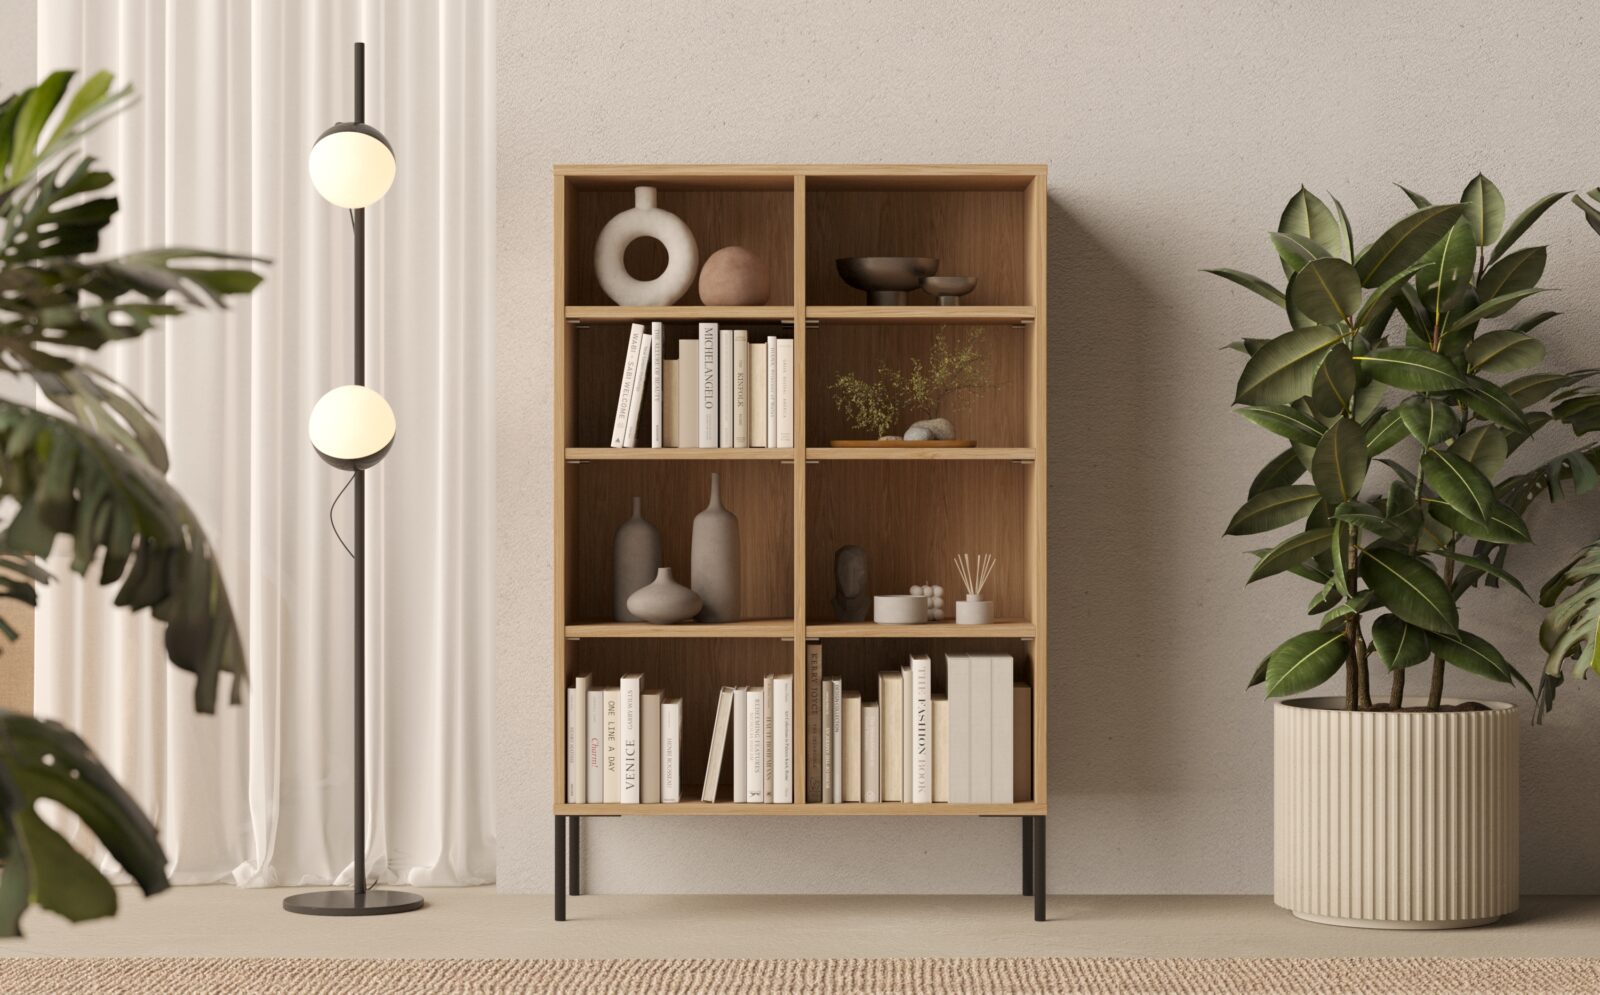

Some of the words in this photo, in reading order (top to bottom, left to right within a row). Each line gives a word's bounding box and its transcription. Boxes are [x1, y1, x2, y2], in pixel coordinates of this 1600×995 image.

[630, 333, 639, 353] WABI
[625, 361, 634, 378] SABI
[704, 327, 714, 409] MICHELANGELO
[619, 380, 631, 419] WELCOME
[810, 652, 818, 683] KERRY
[918, 666, 926, 695] THE
[608, 701, 616, 716] ONE
[608, 721, 616, 741] LINE
[918, 699, 926, 755] FASHION
[591, 737, 600, 768] Charm!
[608, 756, 616, 772] DAY
[625, 740, 635, 790] VENICE
[918, 759, 926, 793] BOOK
